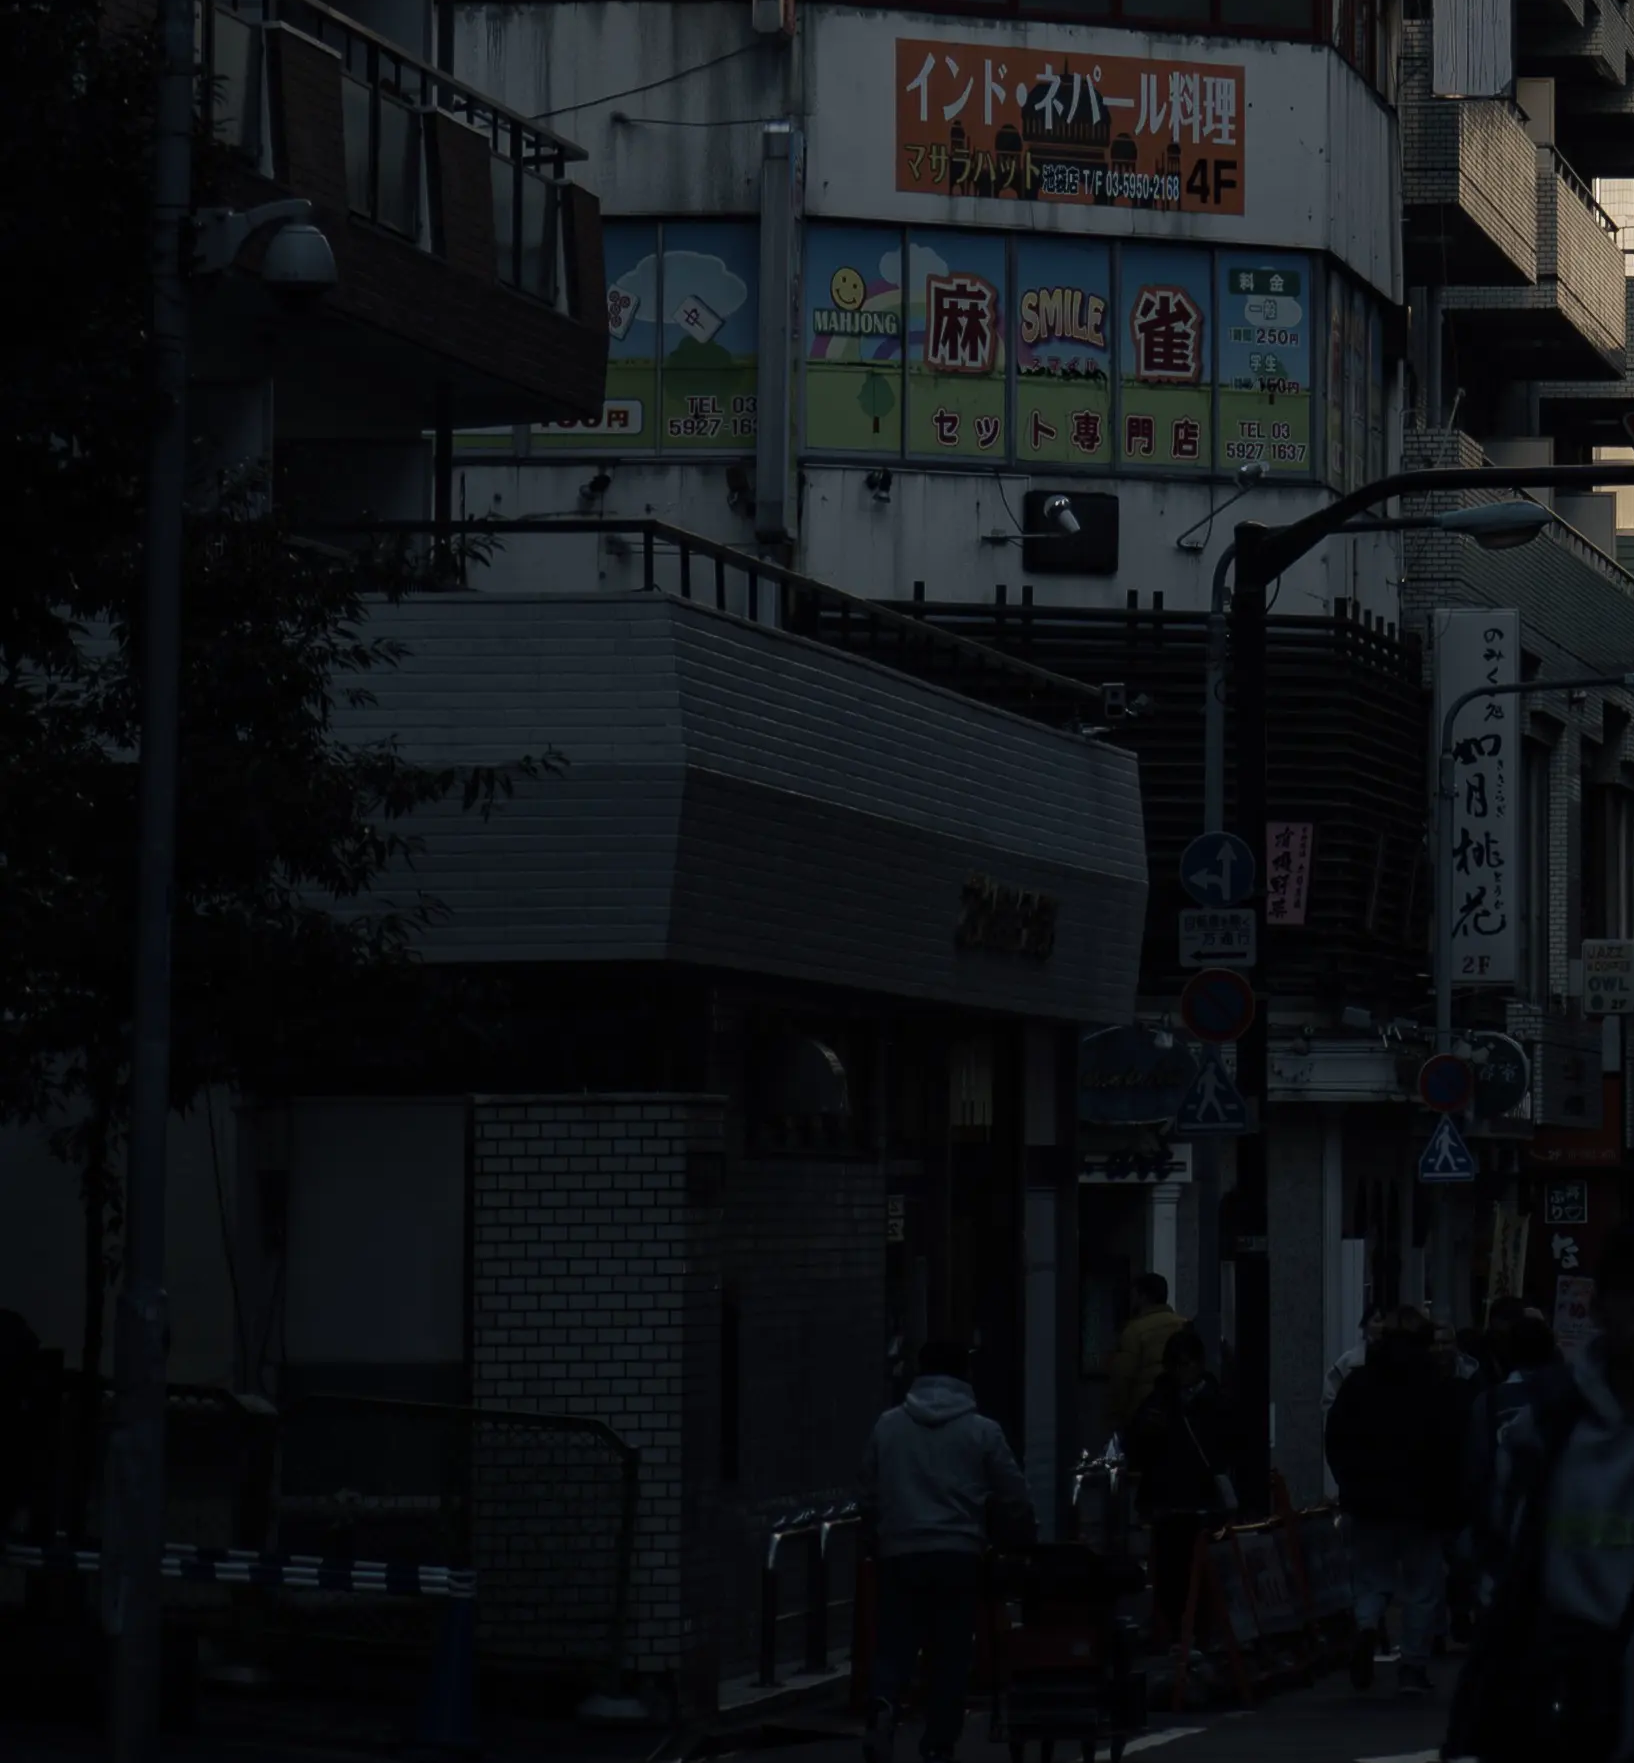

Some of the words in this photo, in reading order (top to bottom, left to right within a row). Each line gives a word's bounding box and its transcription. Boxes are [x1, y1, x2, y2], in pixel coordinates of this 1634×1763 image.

[905, 51, 1237, 146] インド・ネパール料理
[905, 143, 1041, 190] マサラハット
[1041, 165, 1080, 196] 池袋店
[1185, 158, 1238, 205] 4F
[1239, 272, 1285, 293] 料金
[812, 310, 899, 335] MAHJONG
[926, 273, 998, 371] 麻
[1021, 286, 1106, 346] SMILE
[1130, 284, 1204, 384] 雀
[1256, 328, 1300, 346] 250円
[686, 395, 721, 415] TEL
[934, 409, 1200, 461] セット専門店
[1238, 421, 1266, 440] TEL
[1482, 627, 1505, 722] のみく処
[1588, 946, 1624, 959] JAZZ
[1463, 956, 1490, 974] 2F
[1588, 976, 1629, 992] OWL
